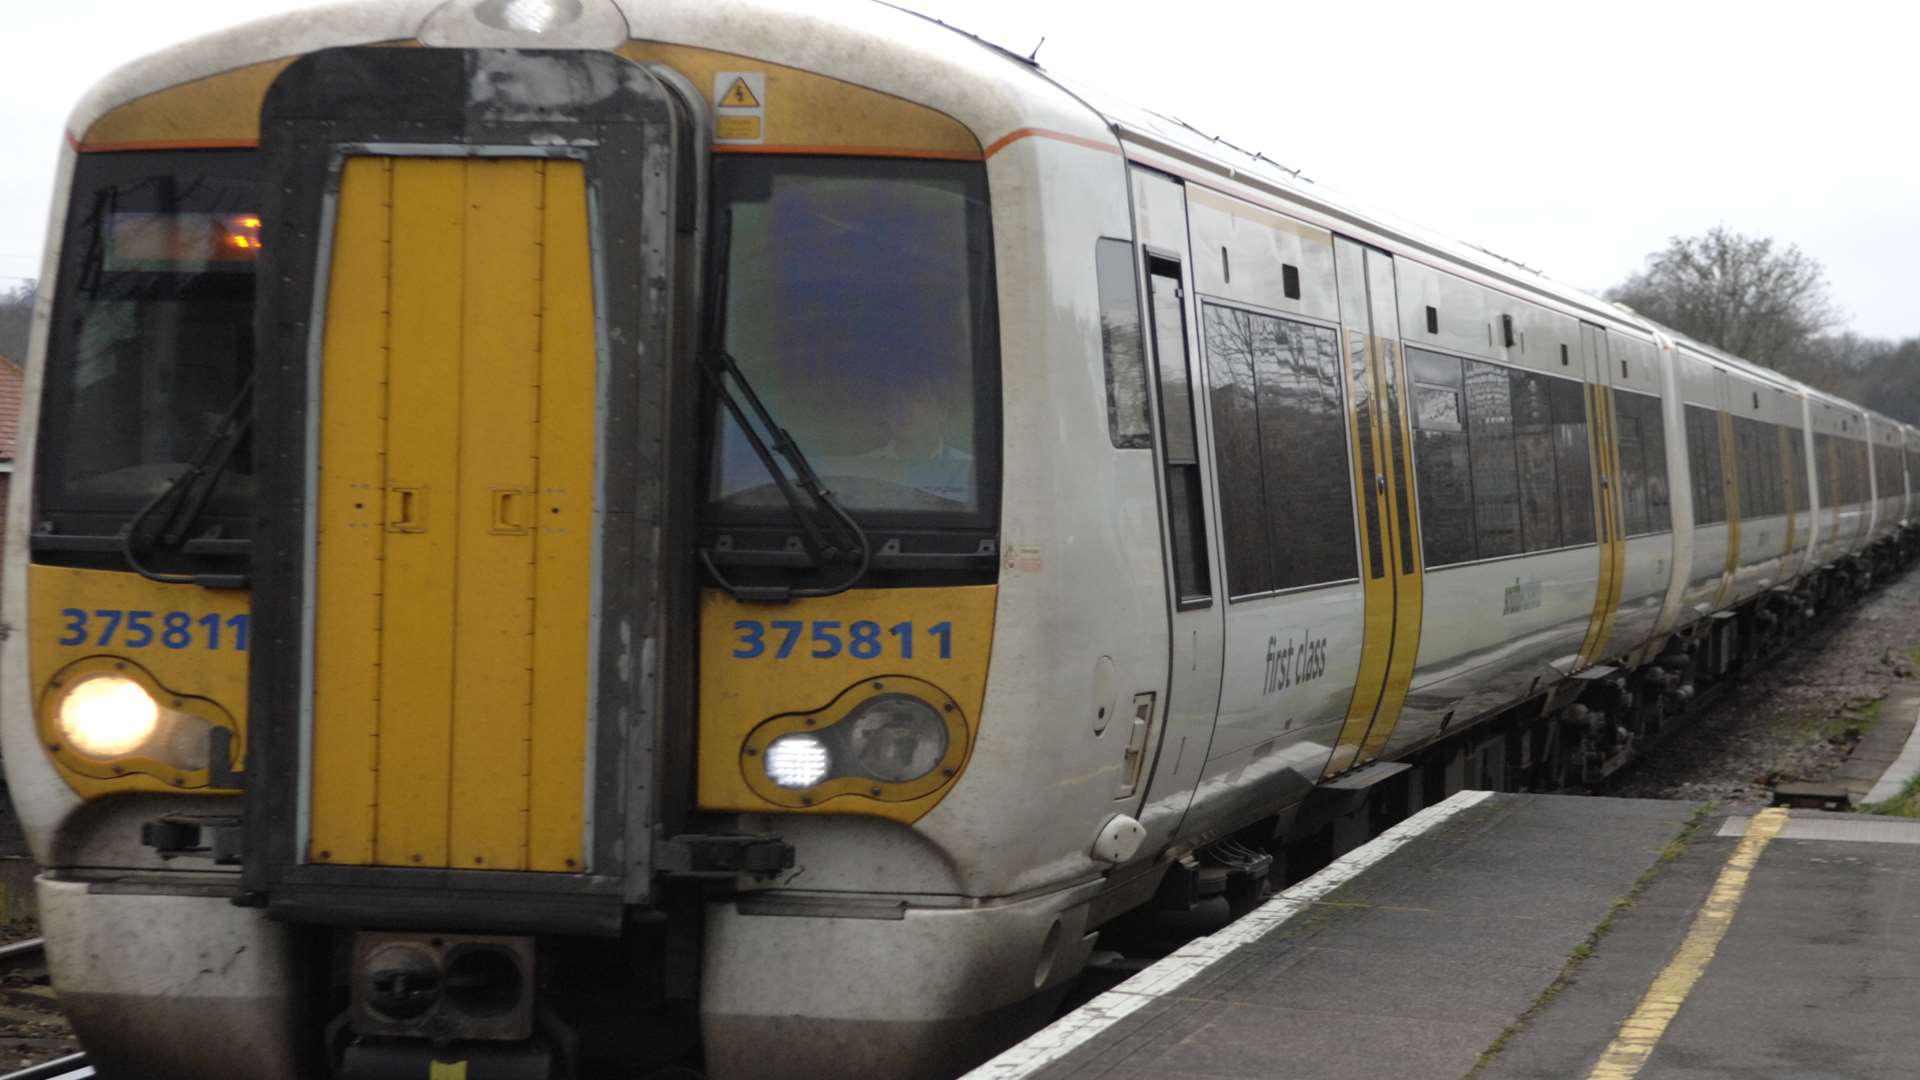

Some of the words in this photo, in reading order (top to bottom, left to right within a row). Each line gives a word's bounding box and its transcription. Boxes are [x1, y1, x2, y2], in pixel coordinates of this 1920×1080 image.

[59, 608, 250, 650] 375811
[733, 620, 952, 659] 375811
[1263, 635, 1294, 696] first
[1296, 629, 1327, 685] class
